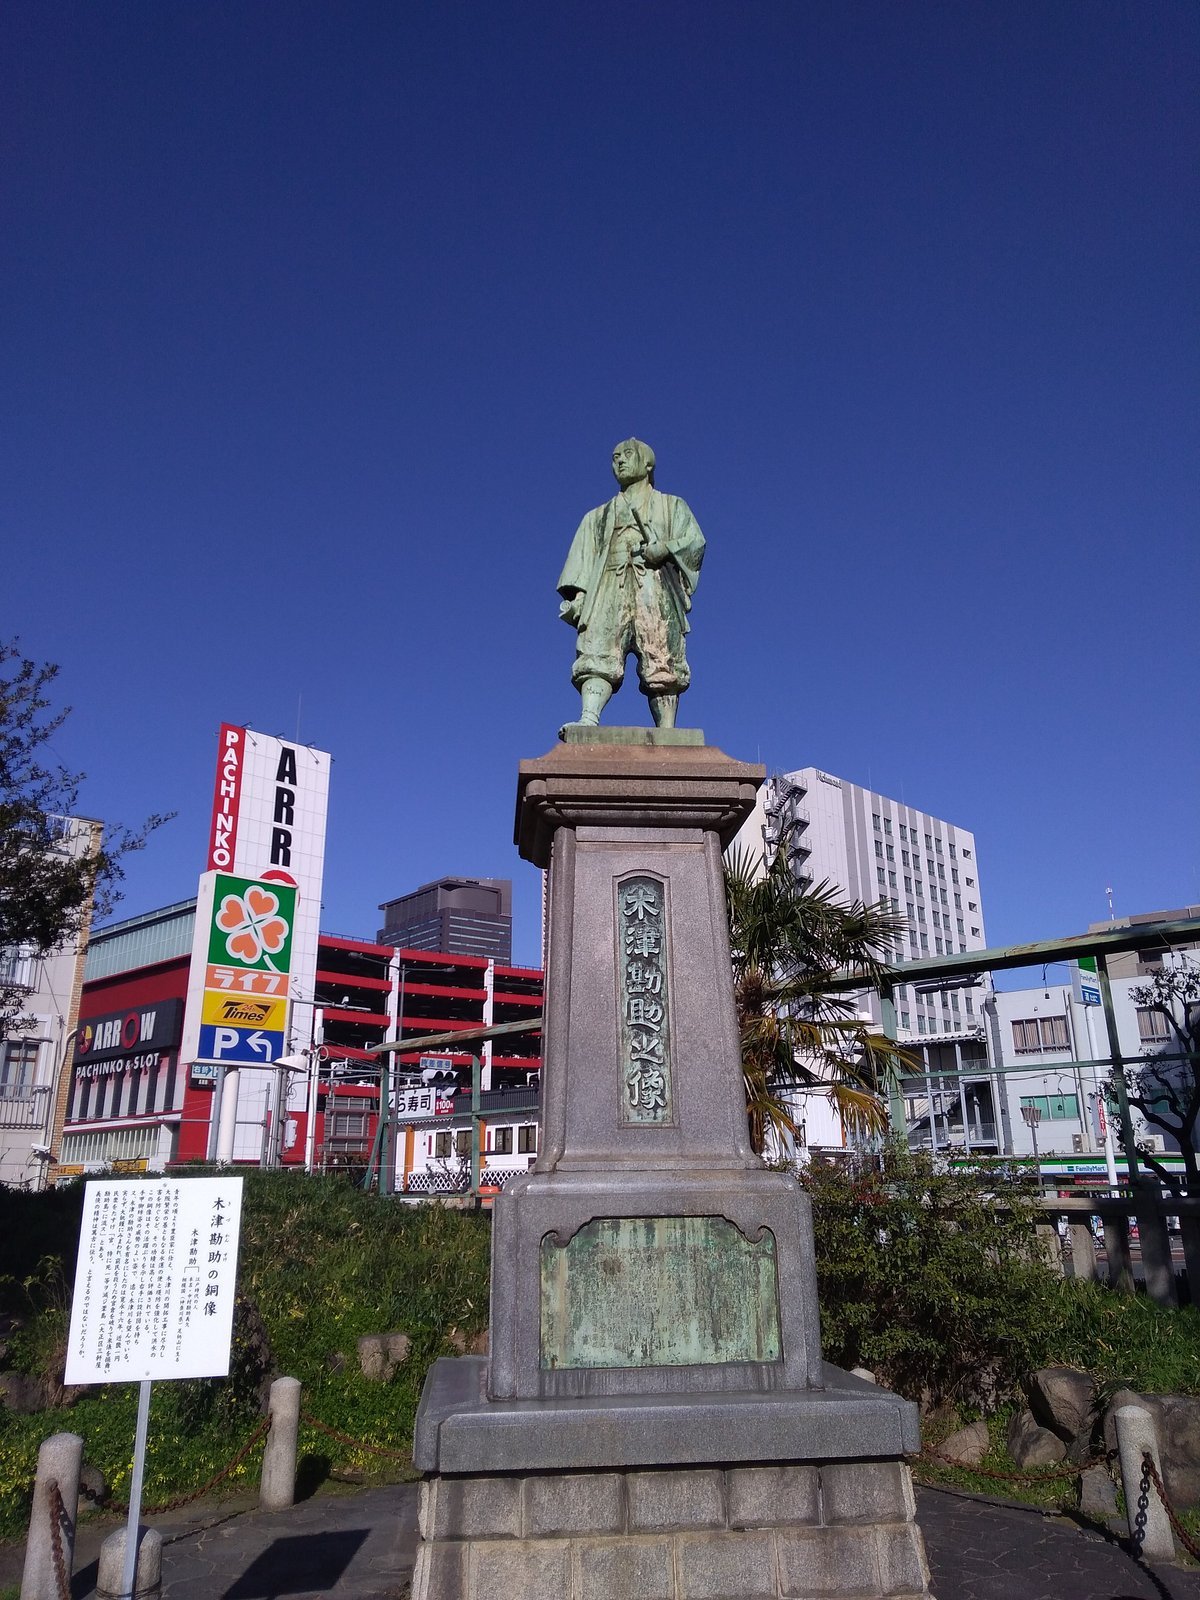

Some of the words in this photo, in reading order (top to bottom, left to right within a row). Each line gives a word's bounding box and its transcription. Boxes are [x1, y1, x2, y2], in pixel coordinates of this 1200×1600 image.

[213, 730, 239, 867] PACHINKO
[213, 968, 281, 993] ライフ
[222, 1001, 265, 1021] Times
[623, 886, 668, 1110] 木津勘助之像
[93, 1011, 156, 1051] ARROW
[213, 1027, 240, 1058] P
[75, 1059, 123, 1079] PACHINKO
[125, 1060, 133, 1071] &
[133, 1052, 160, 1070] SLOT
[1075, 1165, 1106, 1173] FamilyMart
[188, 1228, 199, 1265] 木津勘助
[203, 1196, 225, 1316] 木津勘助の銅像
